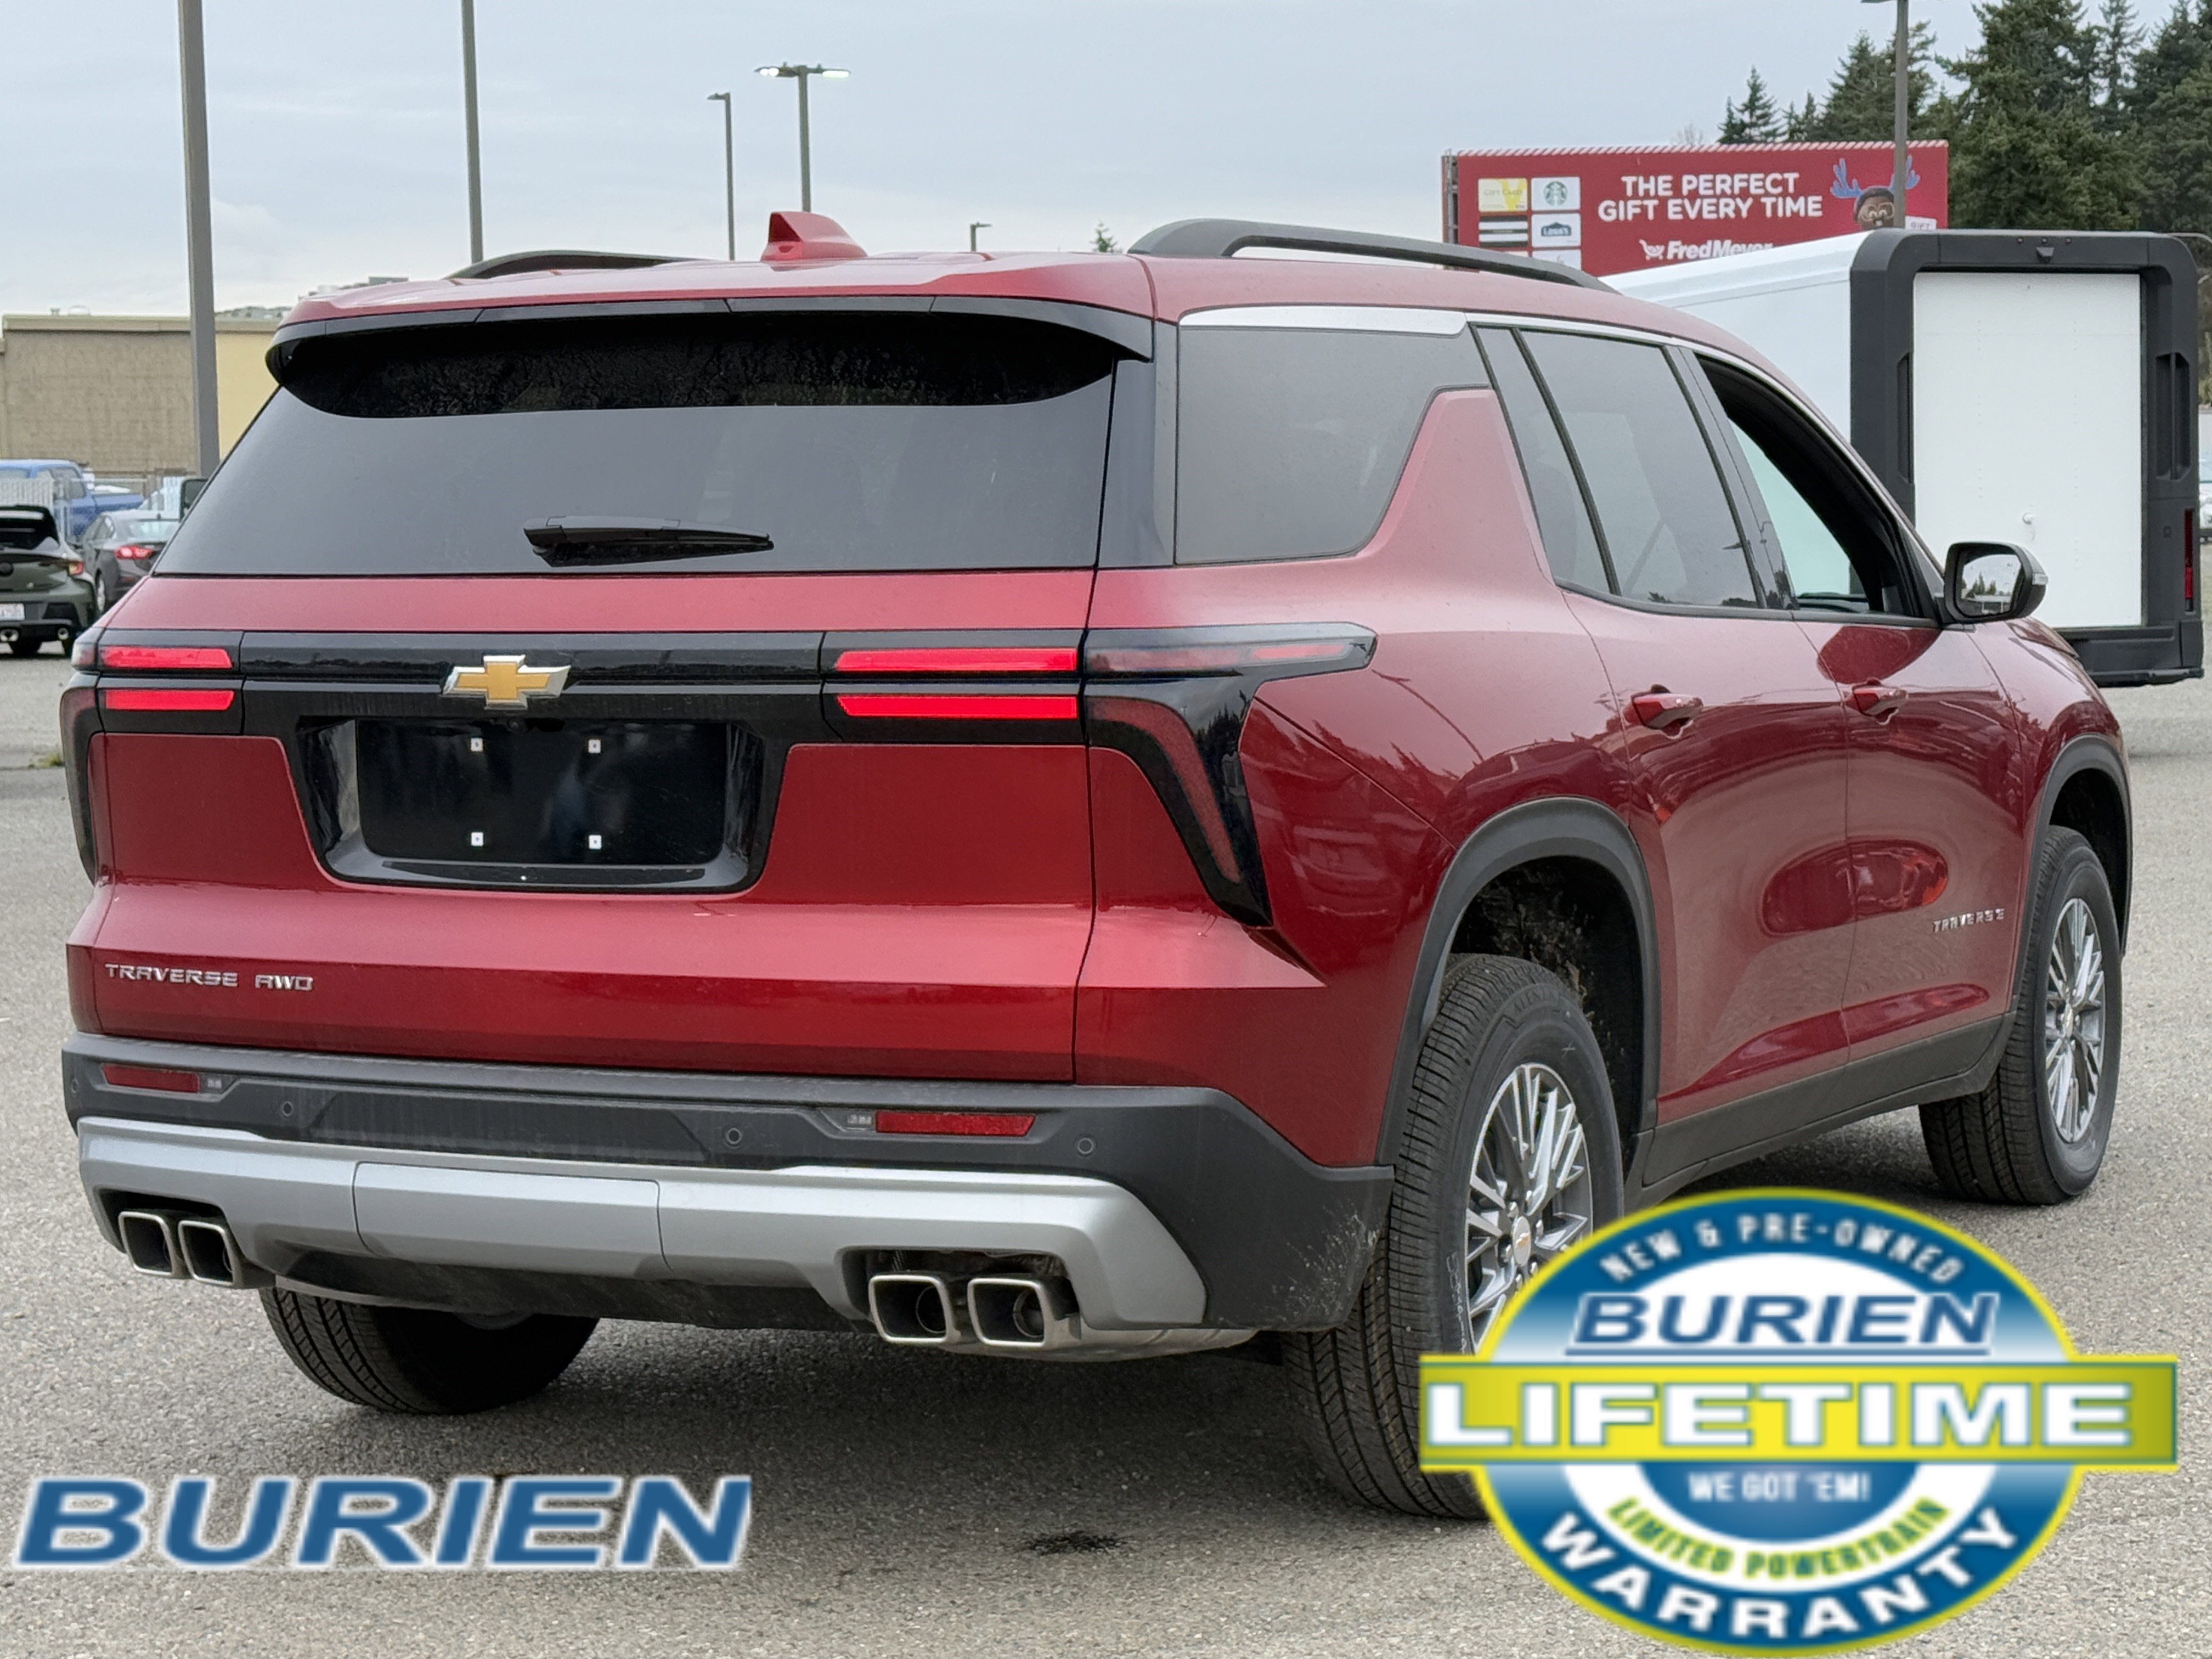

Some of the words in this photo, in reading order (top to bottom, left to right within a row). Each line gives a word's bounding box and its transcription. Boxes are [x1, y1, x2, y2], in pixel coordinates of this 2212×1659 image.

[1621, 175, 1673, 197] THE
[1681, 172, 1800, 196] PERFECT
[1598, 199, 1659, 222] GIFT
[1667, 197, 1753, 220] EVERY
[1760, 195, 1823, 218] TIME
[1933, 908, 2005, 933] TRAVERSE
[105, 963, 238, 987] TRAVERSE
[255, 974, 314, 991] AWD
